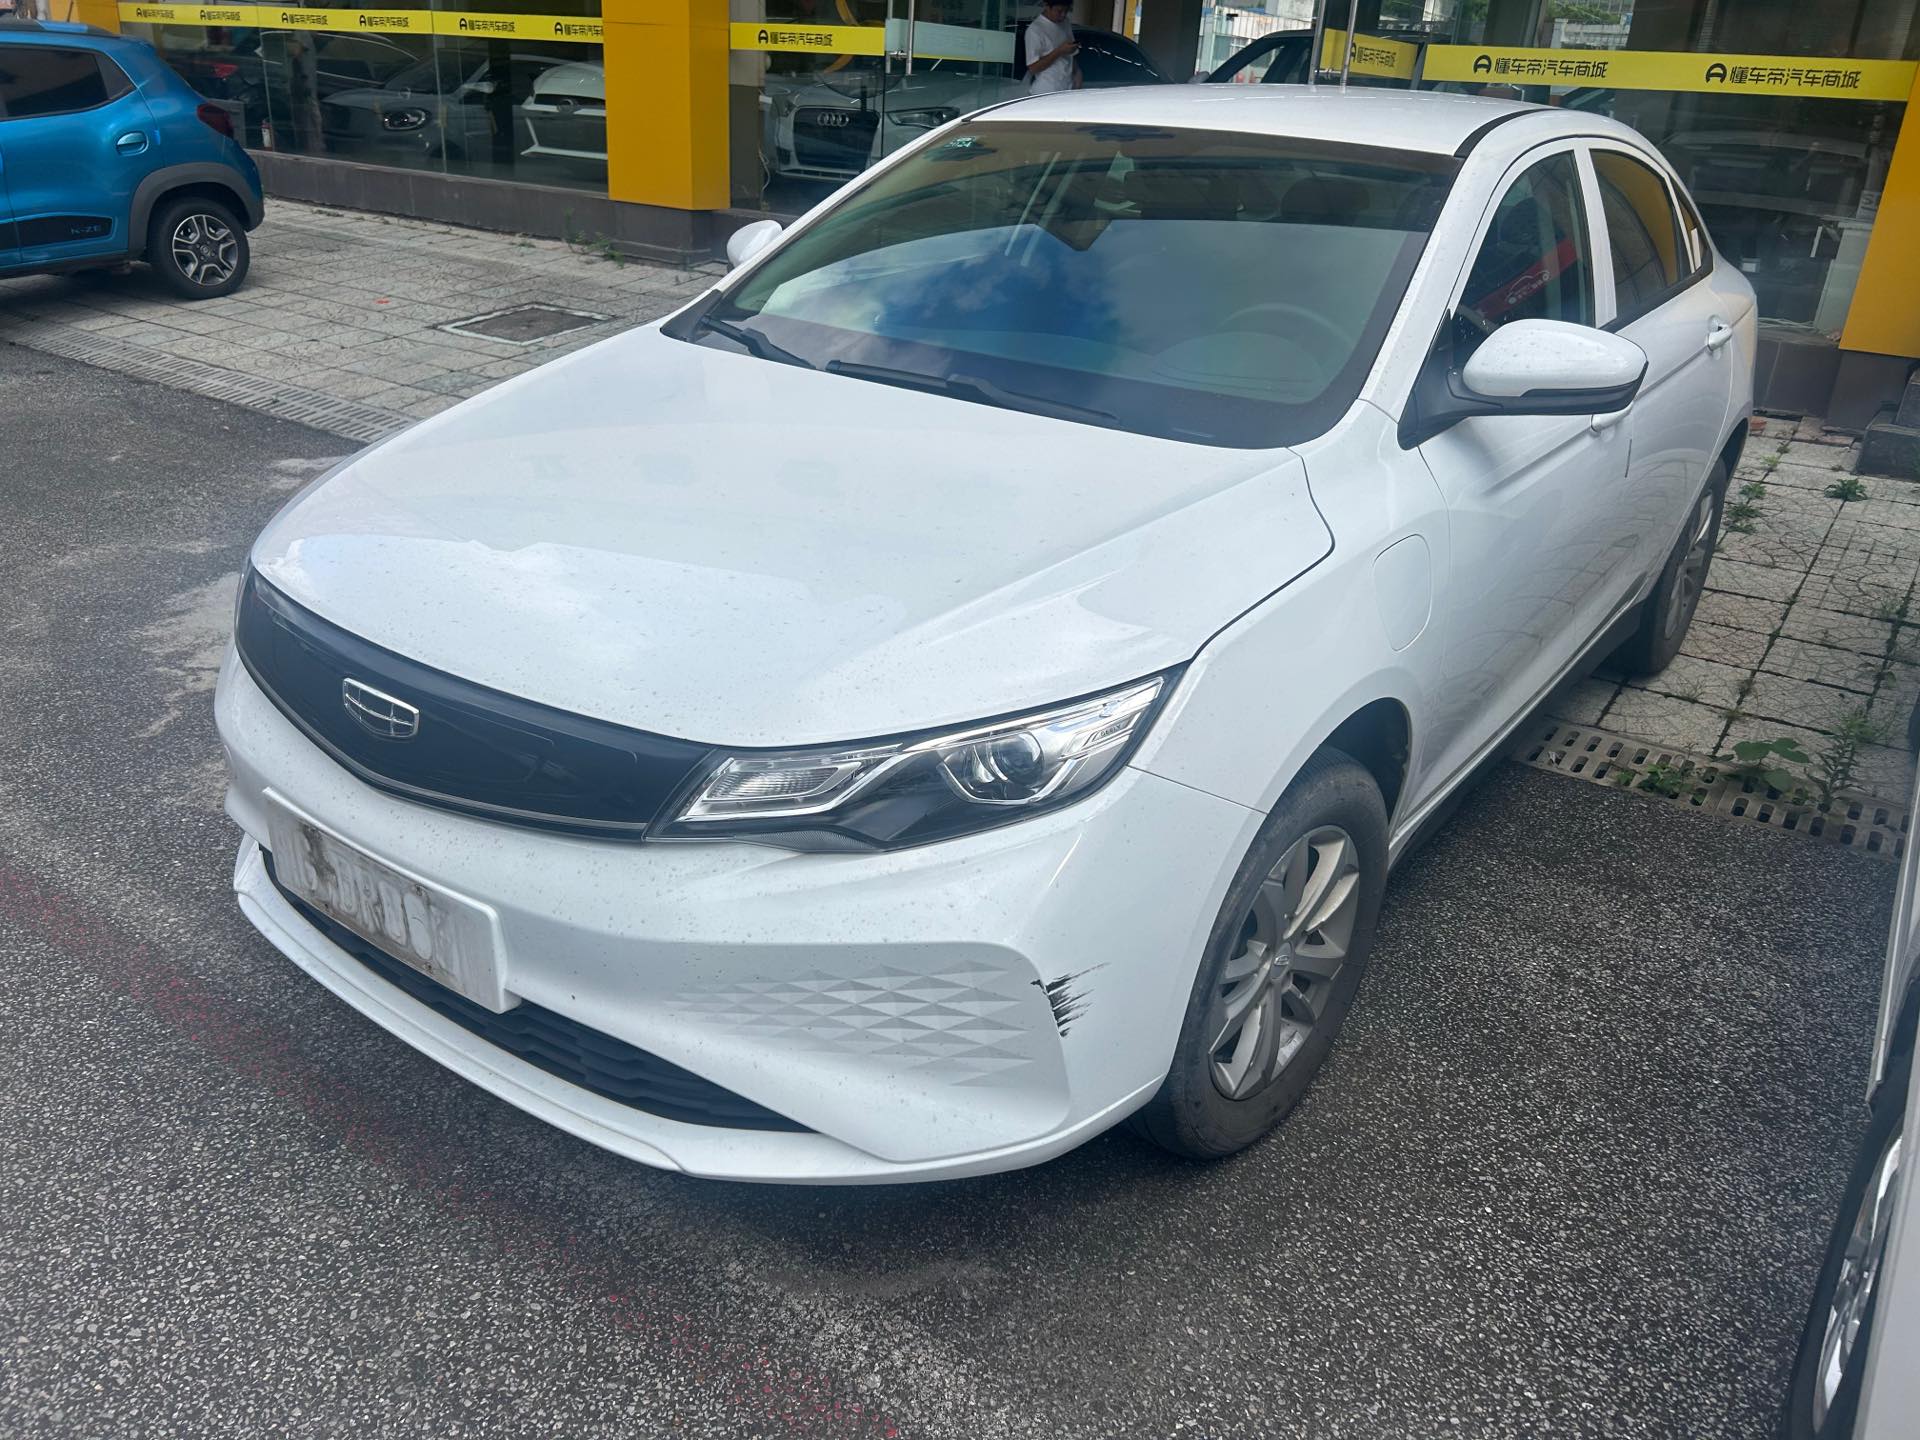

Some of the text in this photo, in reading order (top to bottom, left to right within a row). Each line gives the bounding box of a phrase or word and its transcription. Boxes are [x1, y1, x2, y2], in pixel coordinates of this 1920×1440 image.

[1494, 57, 1609, 78] 懂车帝汽车商城
[1729, 66, 1862, 89] 懂车帝汽车商城
